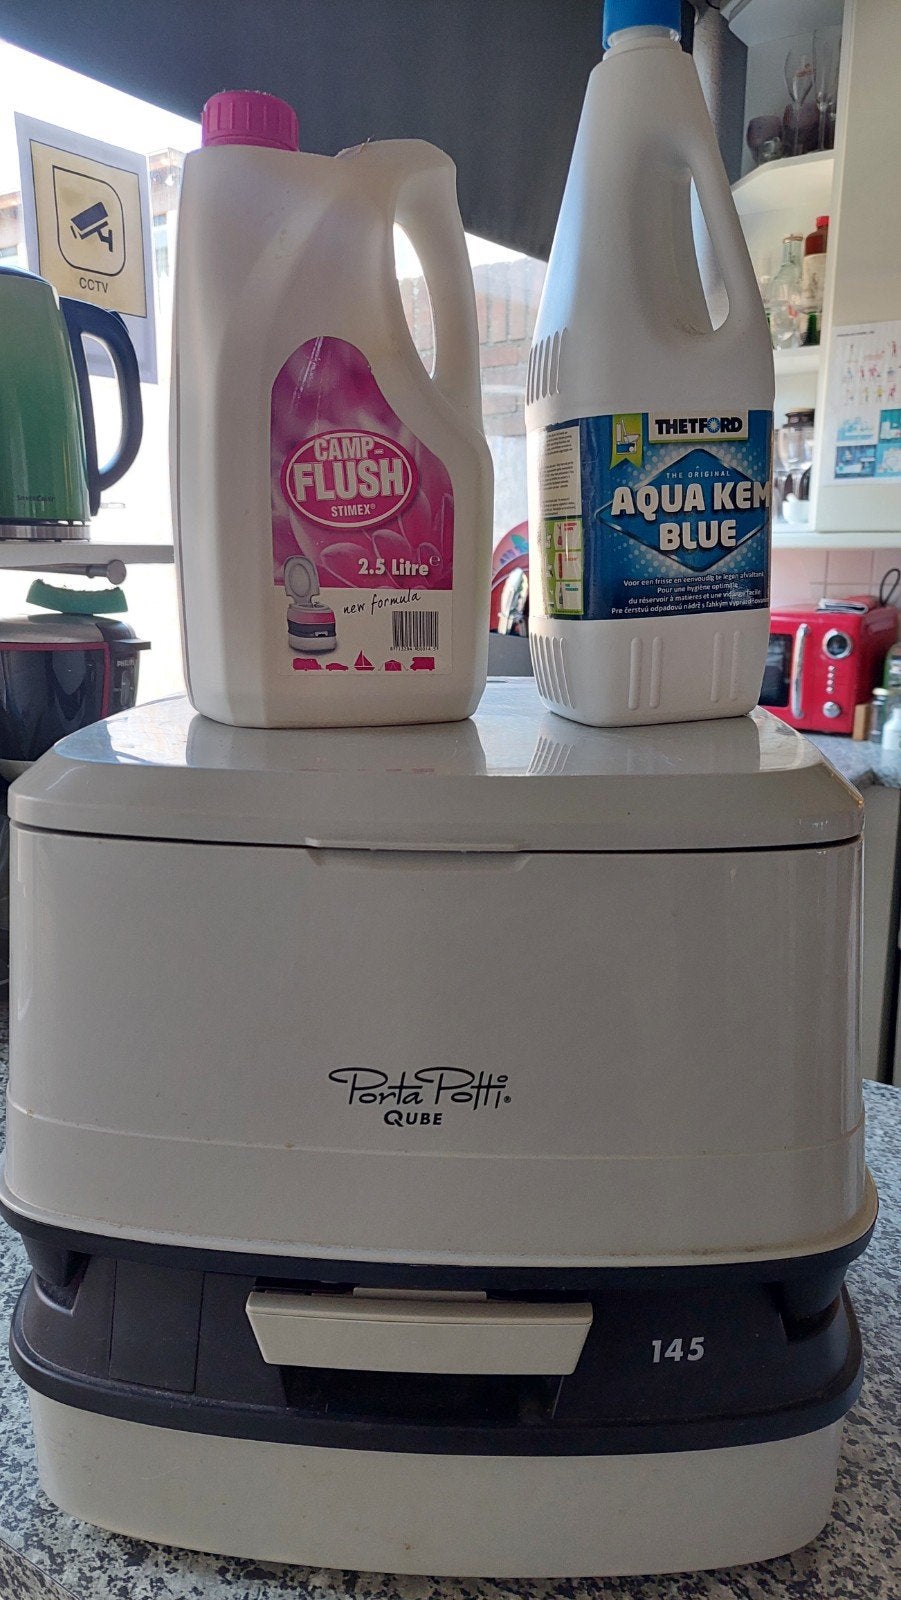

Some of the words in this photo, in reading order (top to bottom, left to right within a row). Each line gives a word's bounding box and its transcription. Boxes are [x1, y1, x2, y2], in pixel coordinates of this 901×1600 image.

[80, 278, 108, 293] CCTV
[655, 417, 743, 435] THETFORD
[314, 436, 384, 461] CAMP-
[293, 457, 405, 503] FLUSH
[688, 470, 731, 479] ORIGINAL
[611, 483, 705, 521] AQUA
[713, 481, 770, 510] KEM
[659, 519, 737, 551] BLUE
[358, 558, 385, 575] 2.5
[391, 558, 429, 576] Litre
[623, 579, 640, 587] Voor
[655, 577, 673, 585] frisse
[343, 603, 366, 614] new
[370, 588, 422, 615] formula
[628, 597, 638, 605] du
[611, 607, 624, 615] Pre
[328, 1067, 424, 1105] Porta
[383, 1109, 443, 1127] QUBE
[652, 1336, 705, 1363] 145
